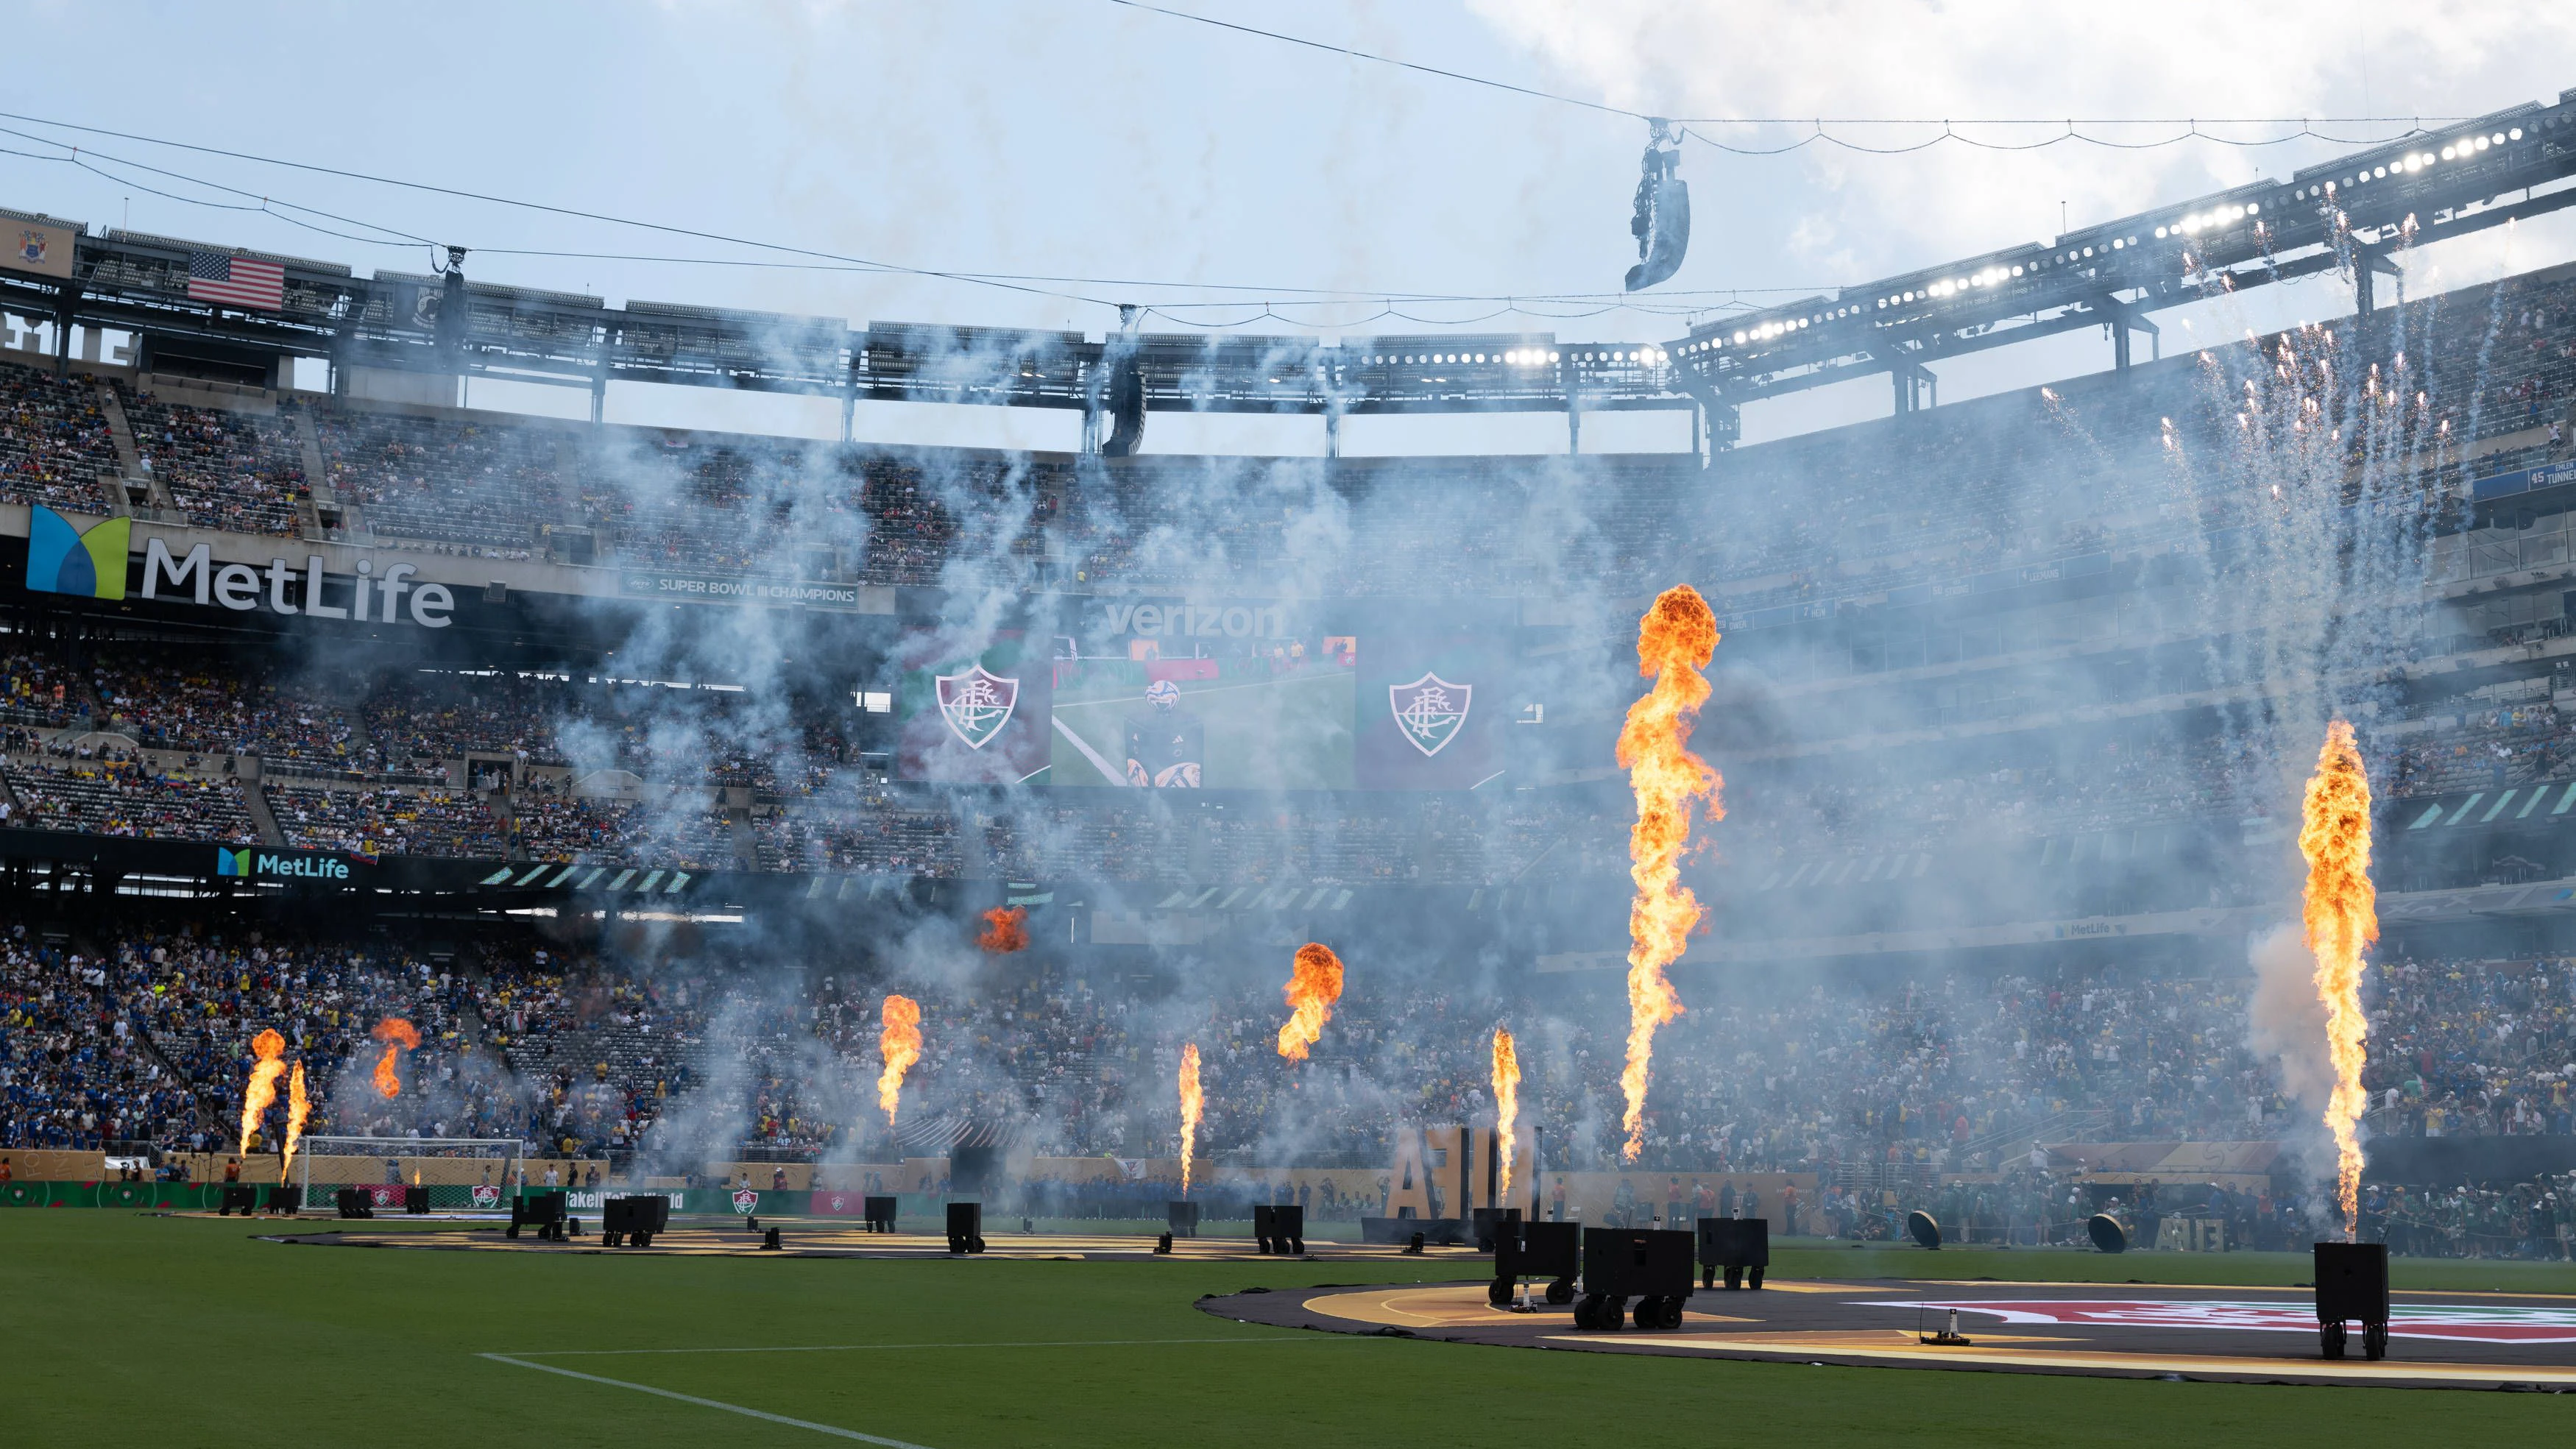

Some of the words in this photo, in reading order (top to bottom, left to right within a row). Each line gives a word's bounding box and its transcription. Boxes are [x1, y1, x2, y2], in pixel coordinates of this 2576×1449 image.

[2531, 471, 2544, 483] 45
[2555, 461, 2574, 472] EMLEN
[141, 537, 455, 628] MetLife
[659, 578, 706, 593] SUPER
[710, 583, 752, 597] BOWL
[757, 586, 768, 598] III
[771, 587, 855, 603] CHAMPIONS
[1105, 603, 1284, 638] verizon
[258, 854, 349, 879] MetLife
[2071, 922, 2110, 935] MetLife
